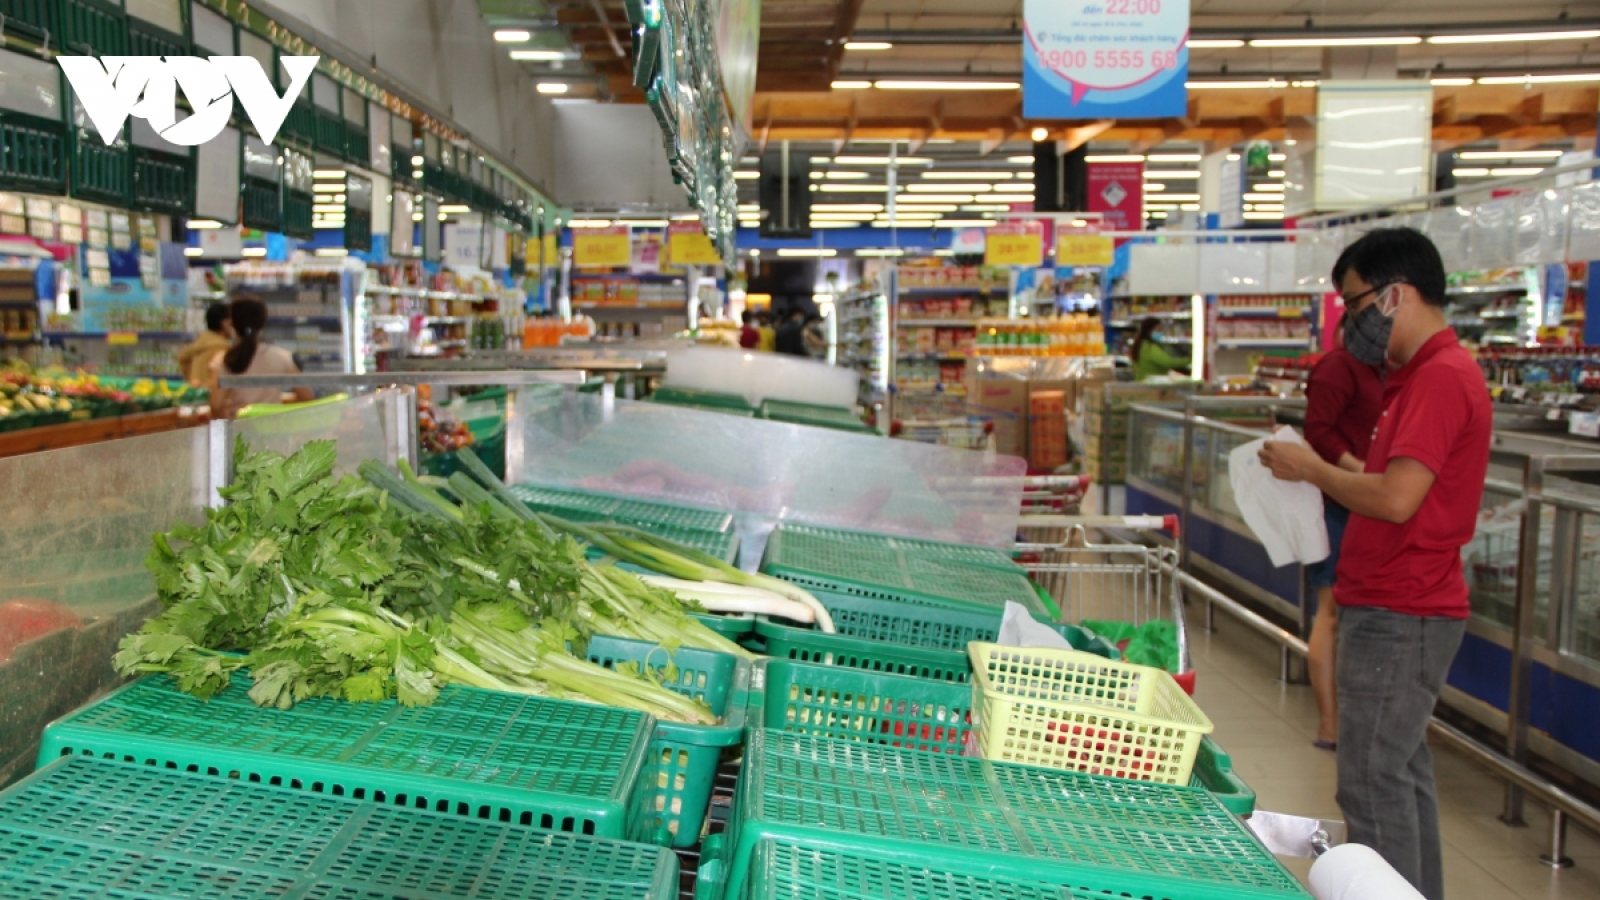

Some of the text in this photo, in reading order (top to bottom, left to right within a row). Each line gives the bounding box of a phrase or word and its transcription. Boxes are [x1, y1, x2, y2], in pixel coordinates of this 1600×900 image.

[1105, 0, 1161, 15] 22:00
[1038, 49, 1177, 69] 1900 5555 68
